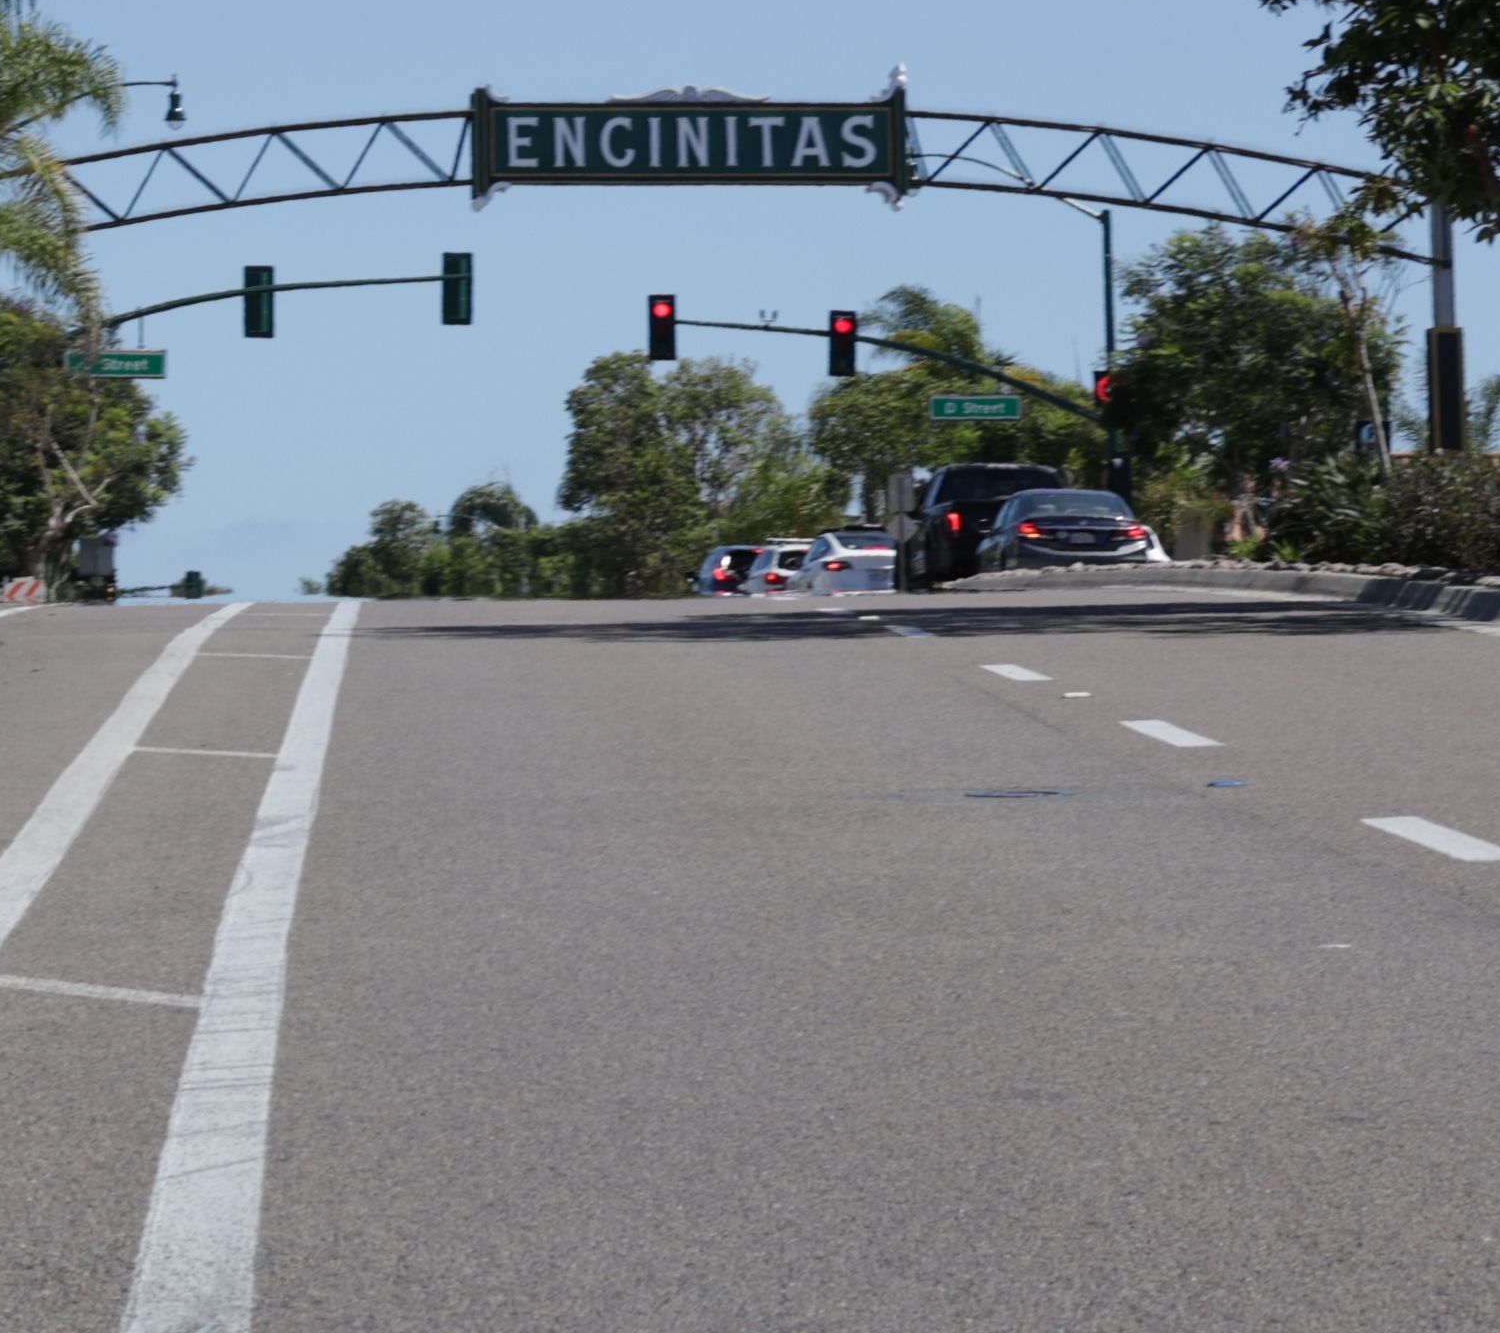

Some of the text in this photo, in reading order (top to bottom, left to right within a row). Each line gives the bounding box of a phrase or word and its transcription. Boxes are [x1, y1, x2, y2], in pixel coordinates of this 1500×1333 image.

[506, 114, 878, 169] ENCINITAS
[101, 358, 150, 371] Street
[962, 401, 1006, 414] Street
